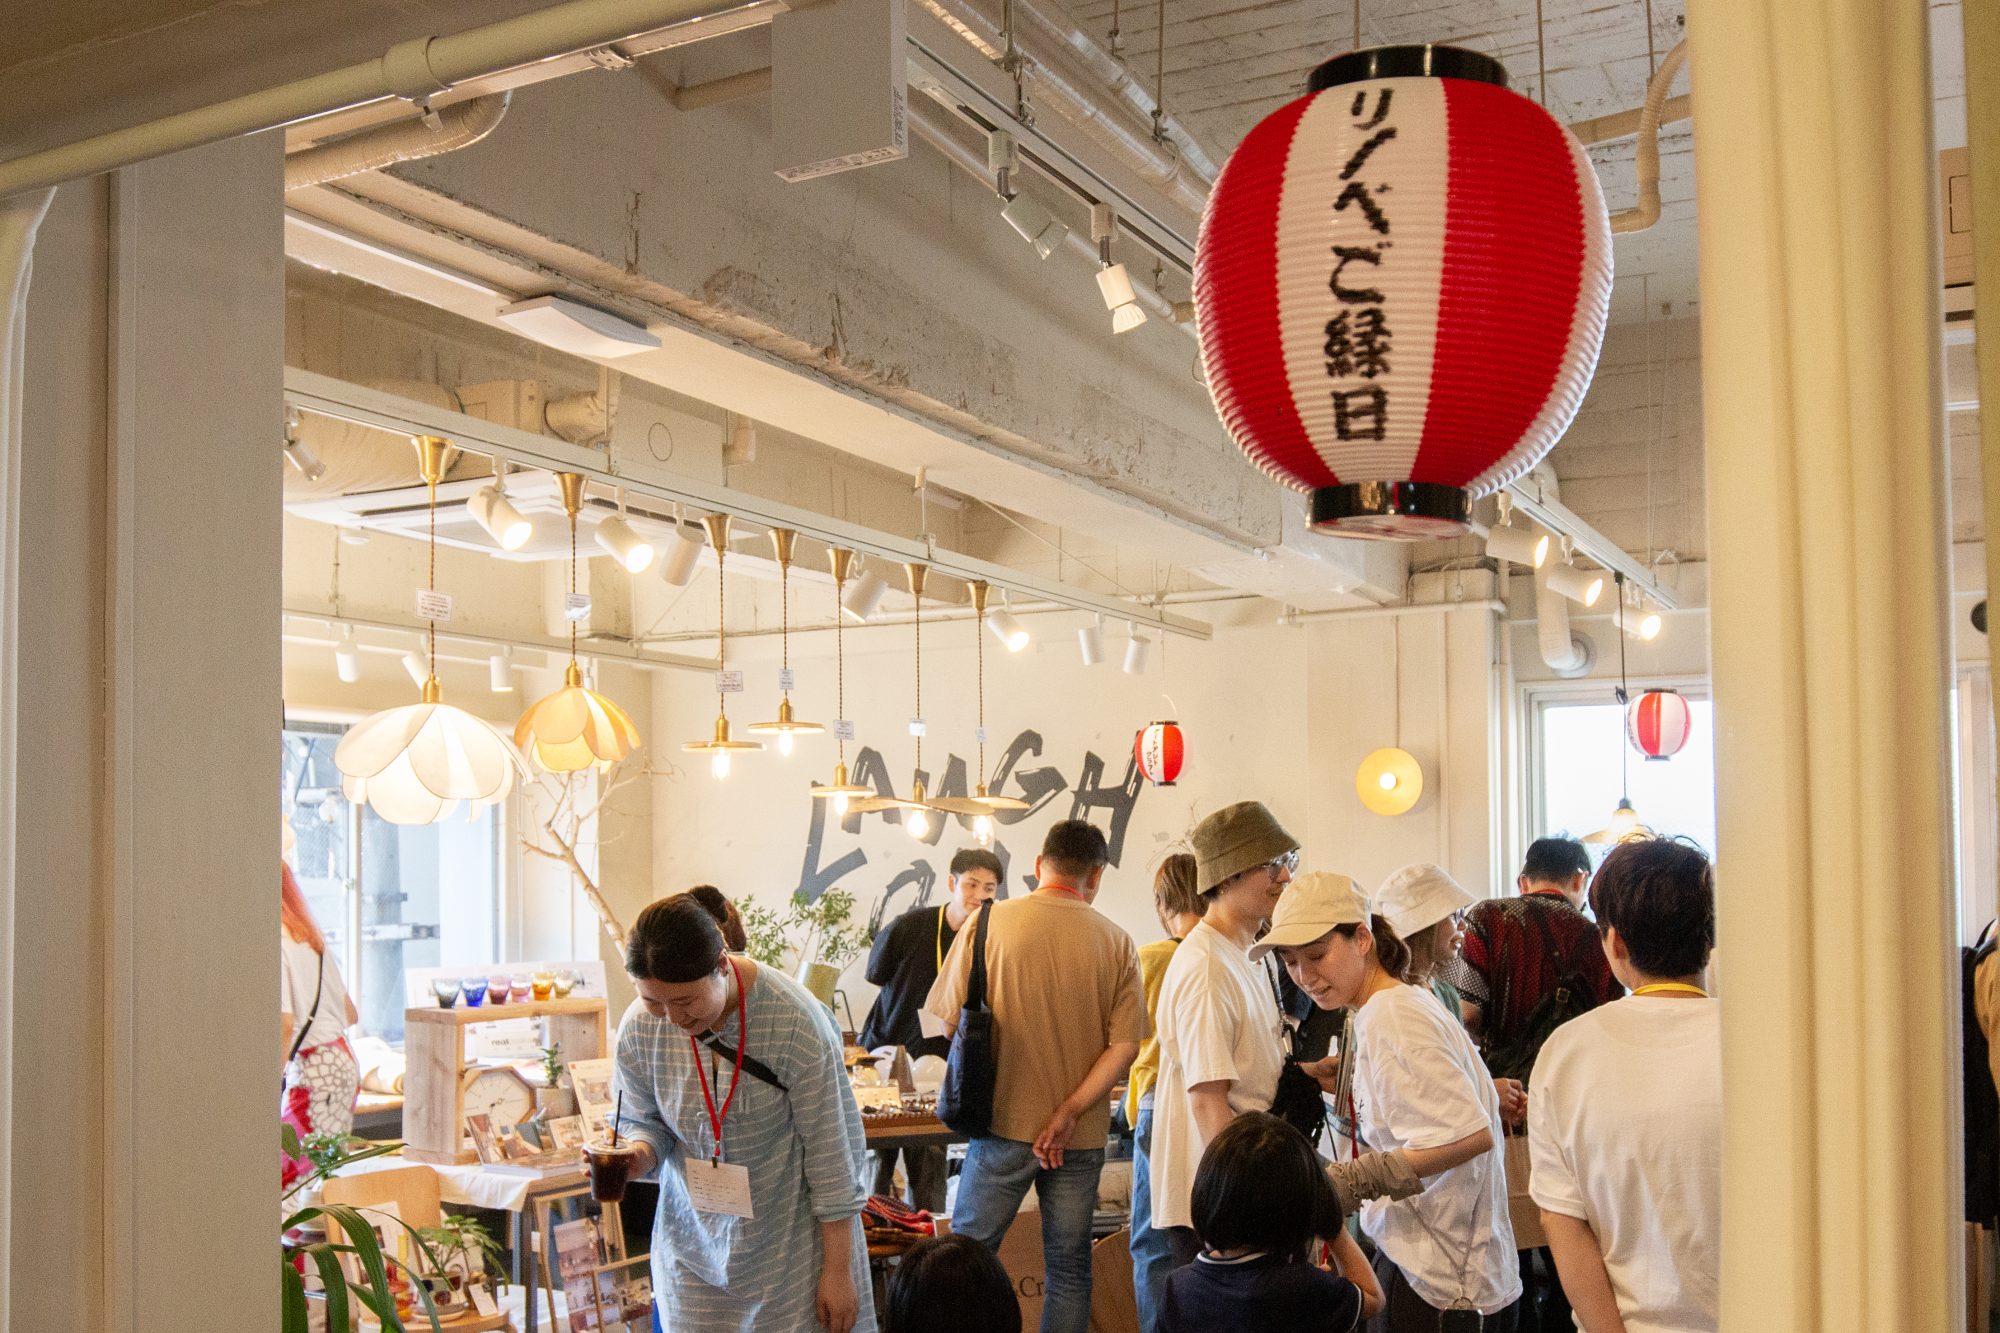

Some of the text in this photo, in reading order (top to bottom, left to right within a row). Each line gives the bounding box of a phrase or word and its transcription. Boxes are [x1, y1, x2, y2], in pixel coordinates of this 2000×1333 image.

[1325, 88, 1397, 440] リノベご縁日
[798, 729, 1144, 906] LAUGH
